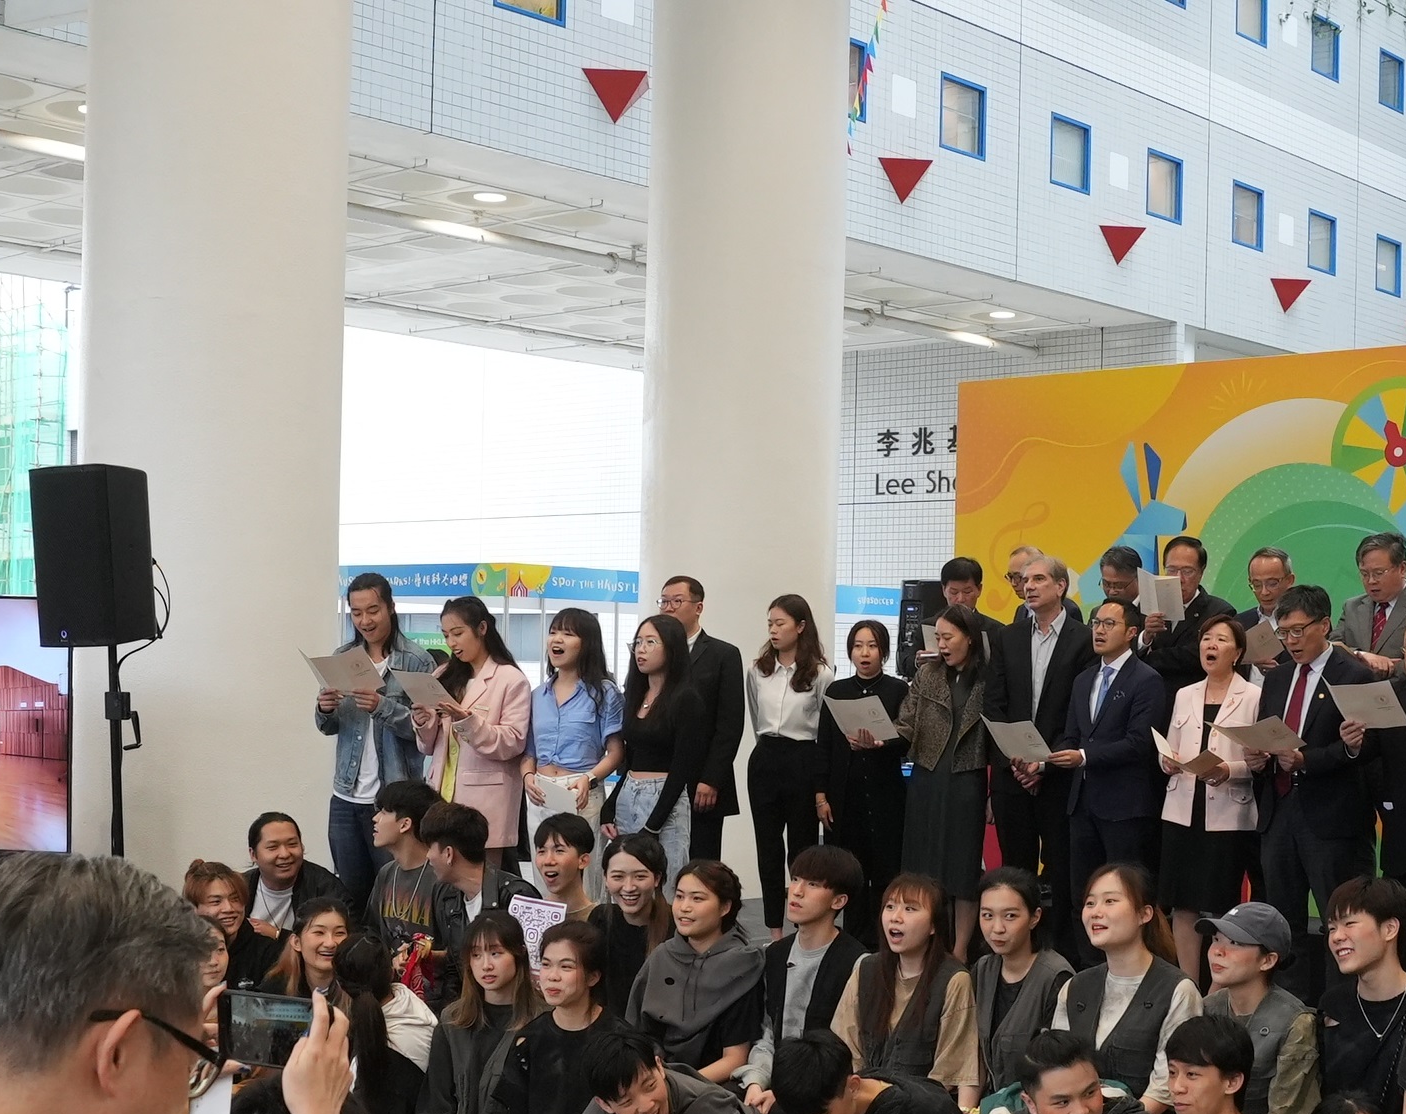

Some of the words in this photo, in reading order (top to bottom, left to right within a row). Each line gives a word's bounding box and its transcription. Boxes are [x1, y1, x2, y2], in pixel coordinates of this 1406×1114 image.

[875, 473, 915, 495] Lee
[926, 470, 956, 493] Sh
[579, 580, 594, 589] THE
